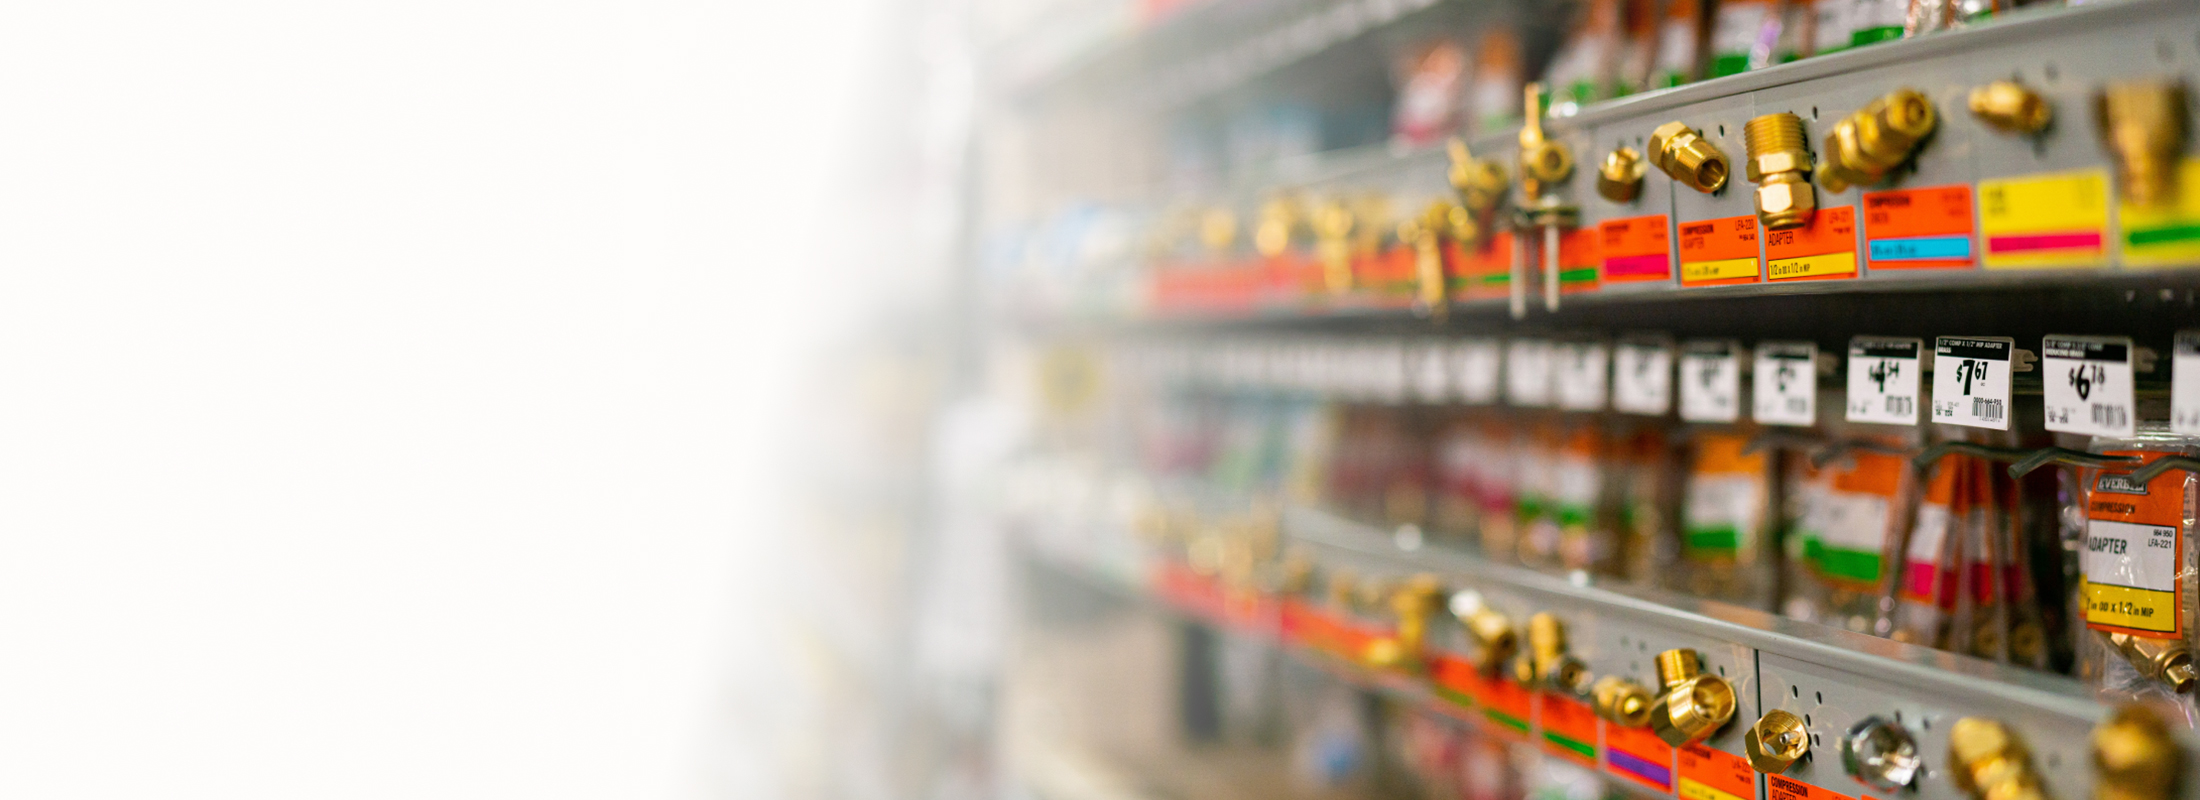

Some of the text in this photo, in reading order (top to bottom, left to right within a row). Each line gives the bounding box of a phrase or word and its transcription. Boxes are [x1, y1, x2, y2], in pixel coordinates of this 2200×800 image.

[1768, 231, 1794, 247] ADAPTER
[1984, 342, 2003, 350] ADAPTER
[2099, 477, 2145, 491] EVERB
[2090, 501, 2135, 514] COMPRESSION
[2088, 536, 2127, 554] ADAPTER
[2148, 538, 2172, 549] LFA-221
[2119, 601, 2133, 615] 1/2
[2141, 606, 2154, 618] MIP
[1771, 776, 1809, 798] COMPRESSION
